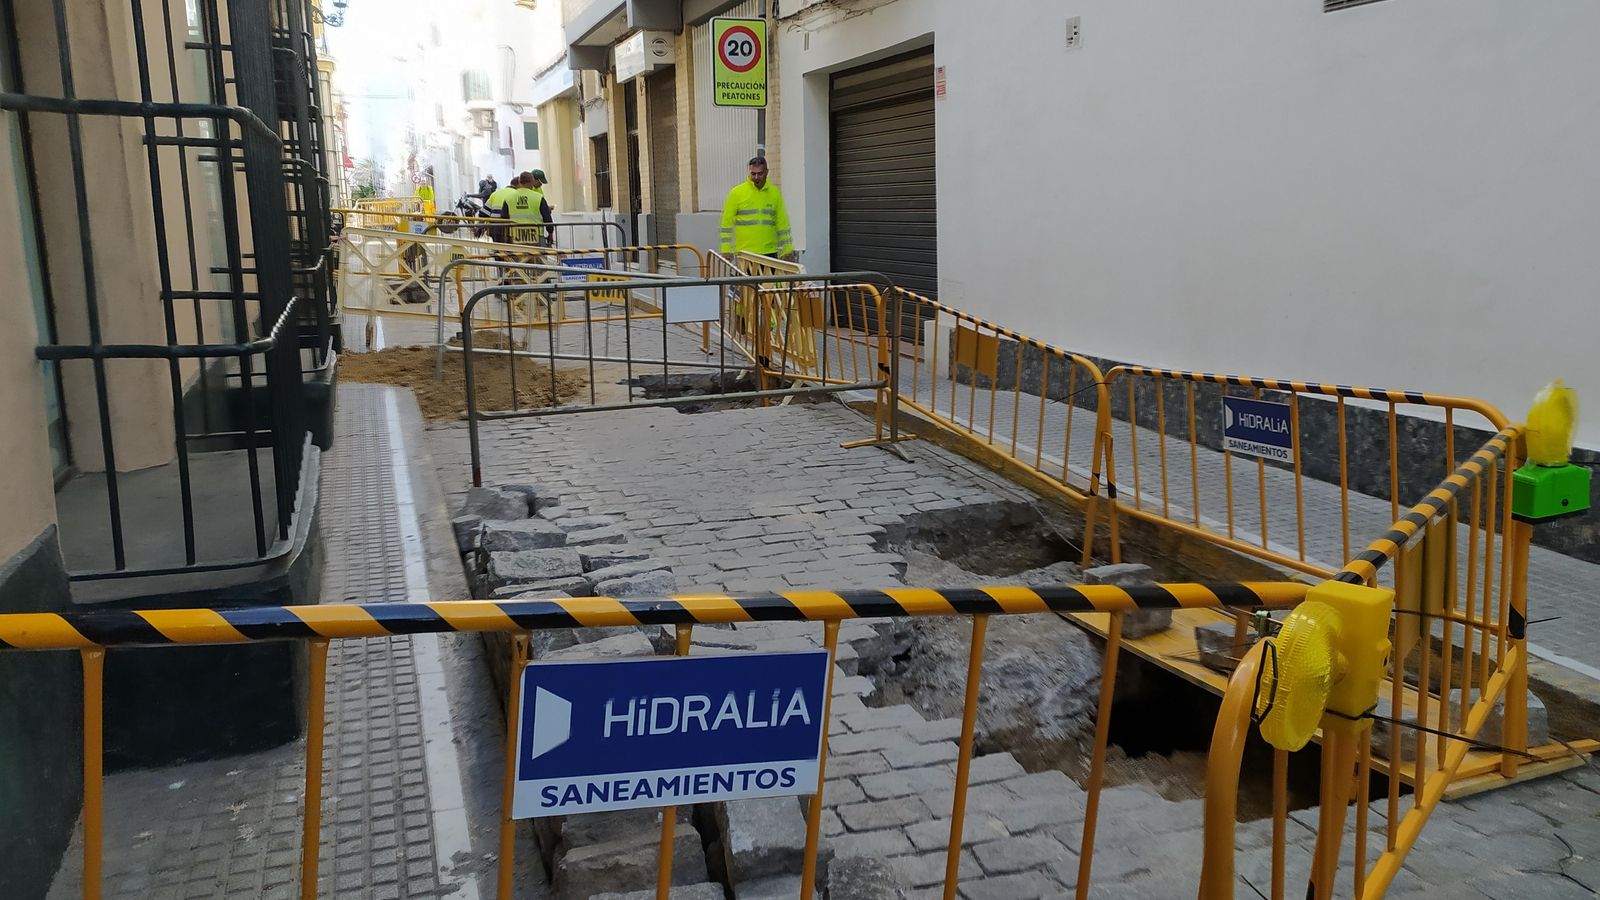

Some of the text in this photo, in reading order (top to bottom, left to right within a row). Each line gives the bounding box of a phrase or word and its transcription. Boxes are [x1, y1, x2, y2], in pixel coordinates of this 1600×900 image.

[727, 39, 753, 57] 20
[716, 80, 765, 90] PRECAUCIÓN
[722, 92, 761, 101] PEATONES
[1229, 439, 1288, 459] SANEAMIENTOS
[540, 767, 796, 808] SANEAMIENTOS
